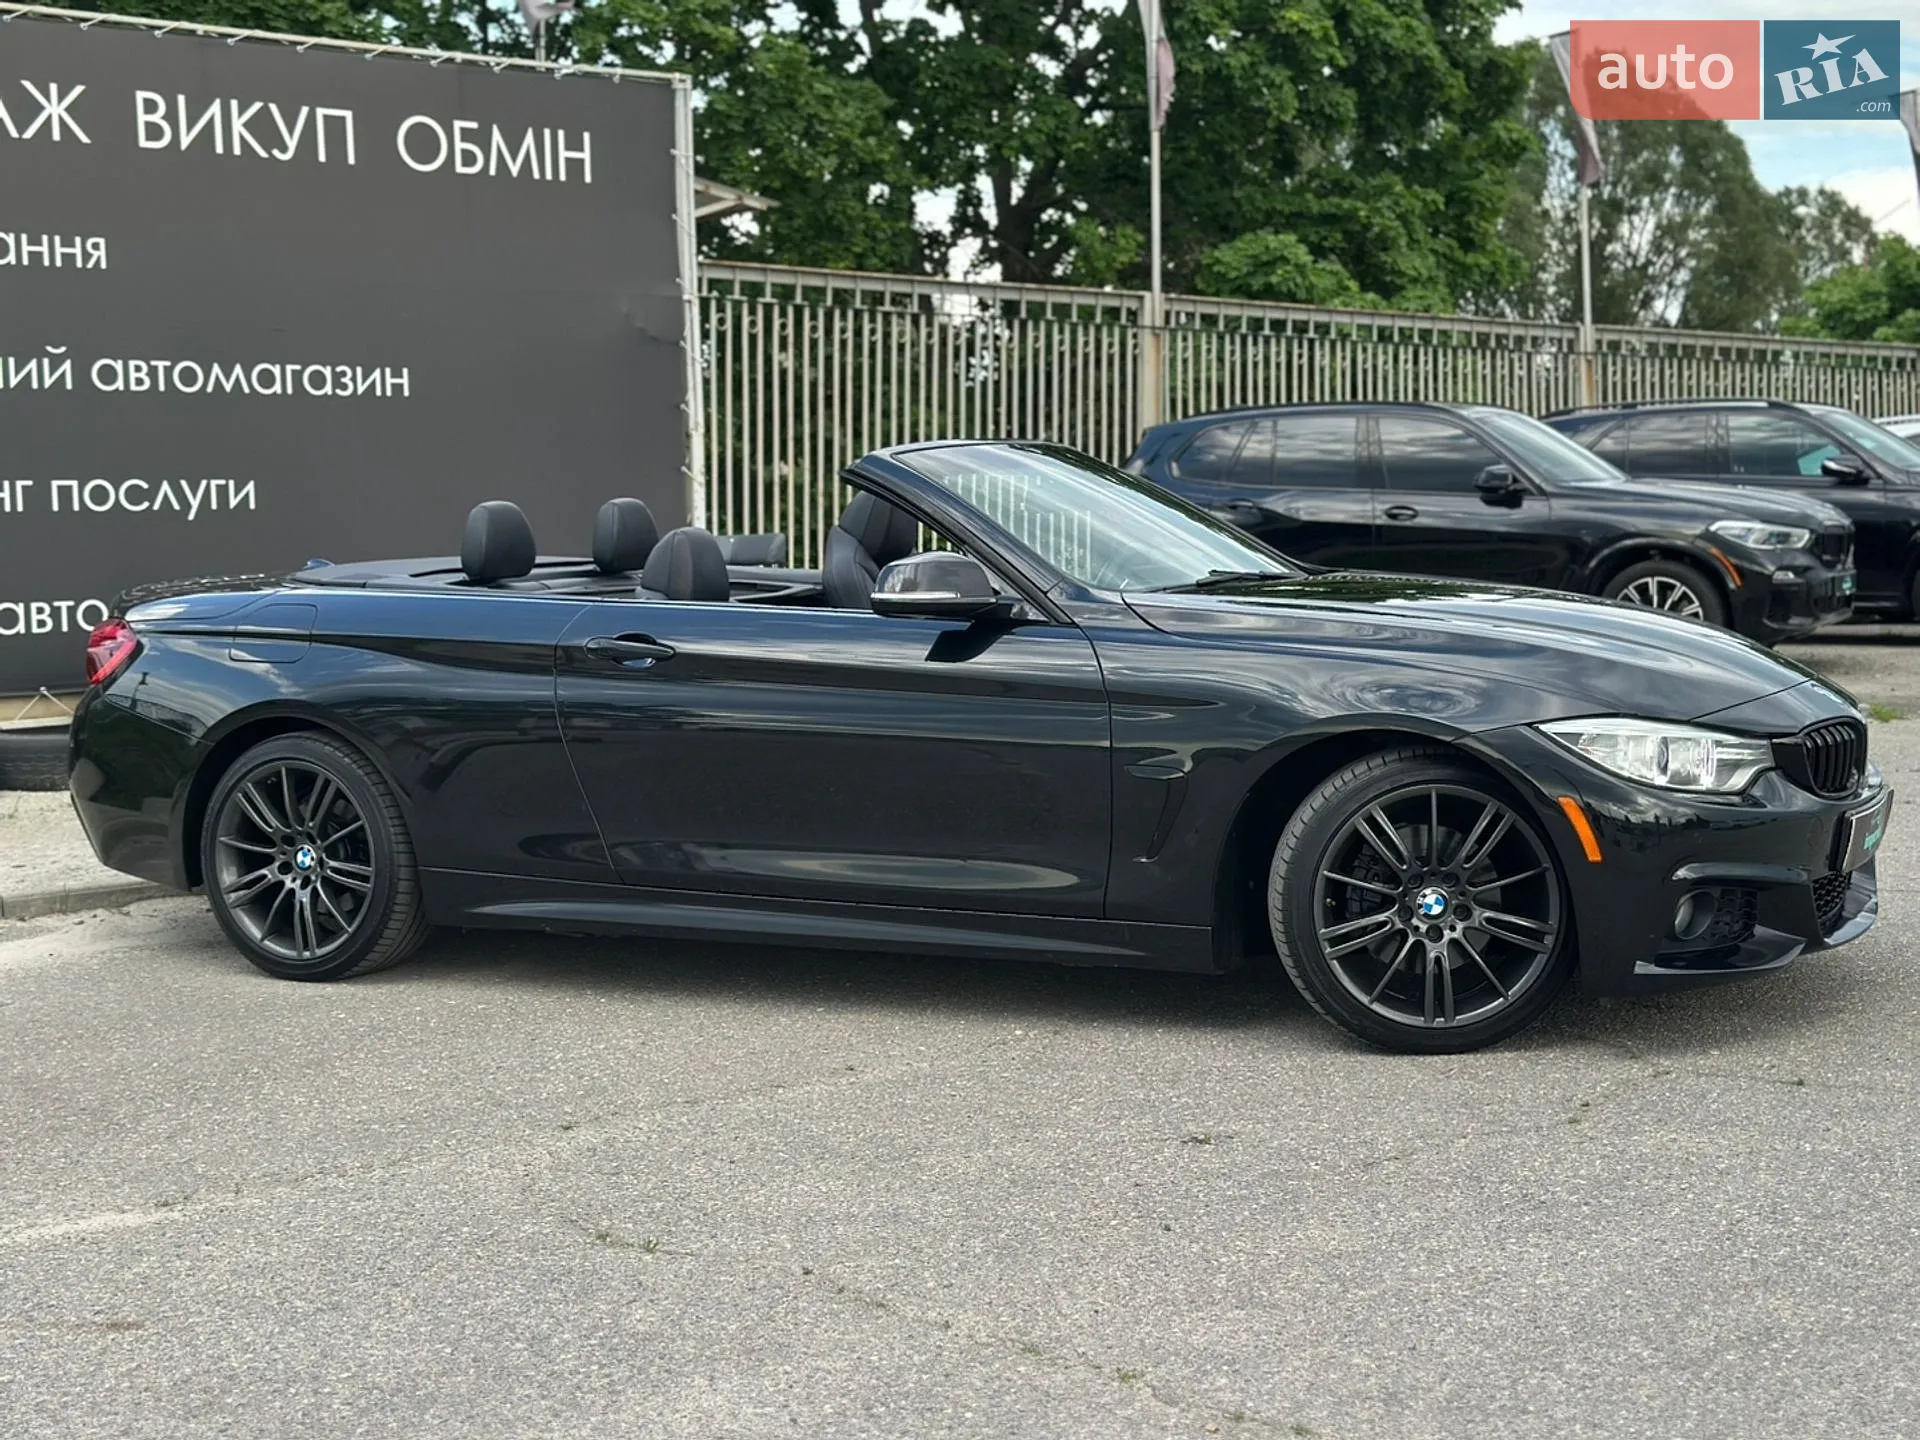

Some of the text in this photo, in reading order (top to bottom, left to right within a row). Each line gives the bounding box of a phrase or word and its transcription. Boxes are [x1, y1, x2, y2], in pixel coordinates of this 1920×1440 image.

[134, 89, 356, 166] ВИКУП
[396, 114, 592, 184] ОБМІН
[0, 345, 410, 397] ий автомагазин
[50, 478, 256, 521] послуги
